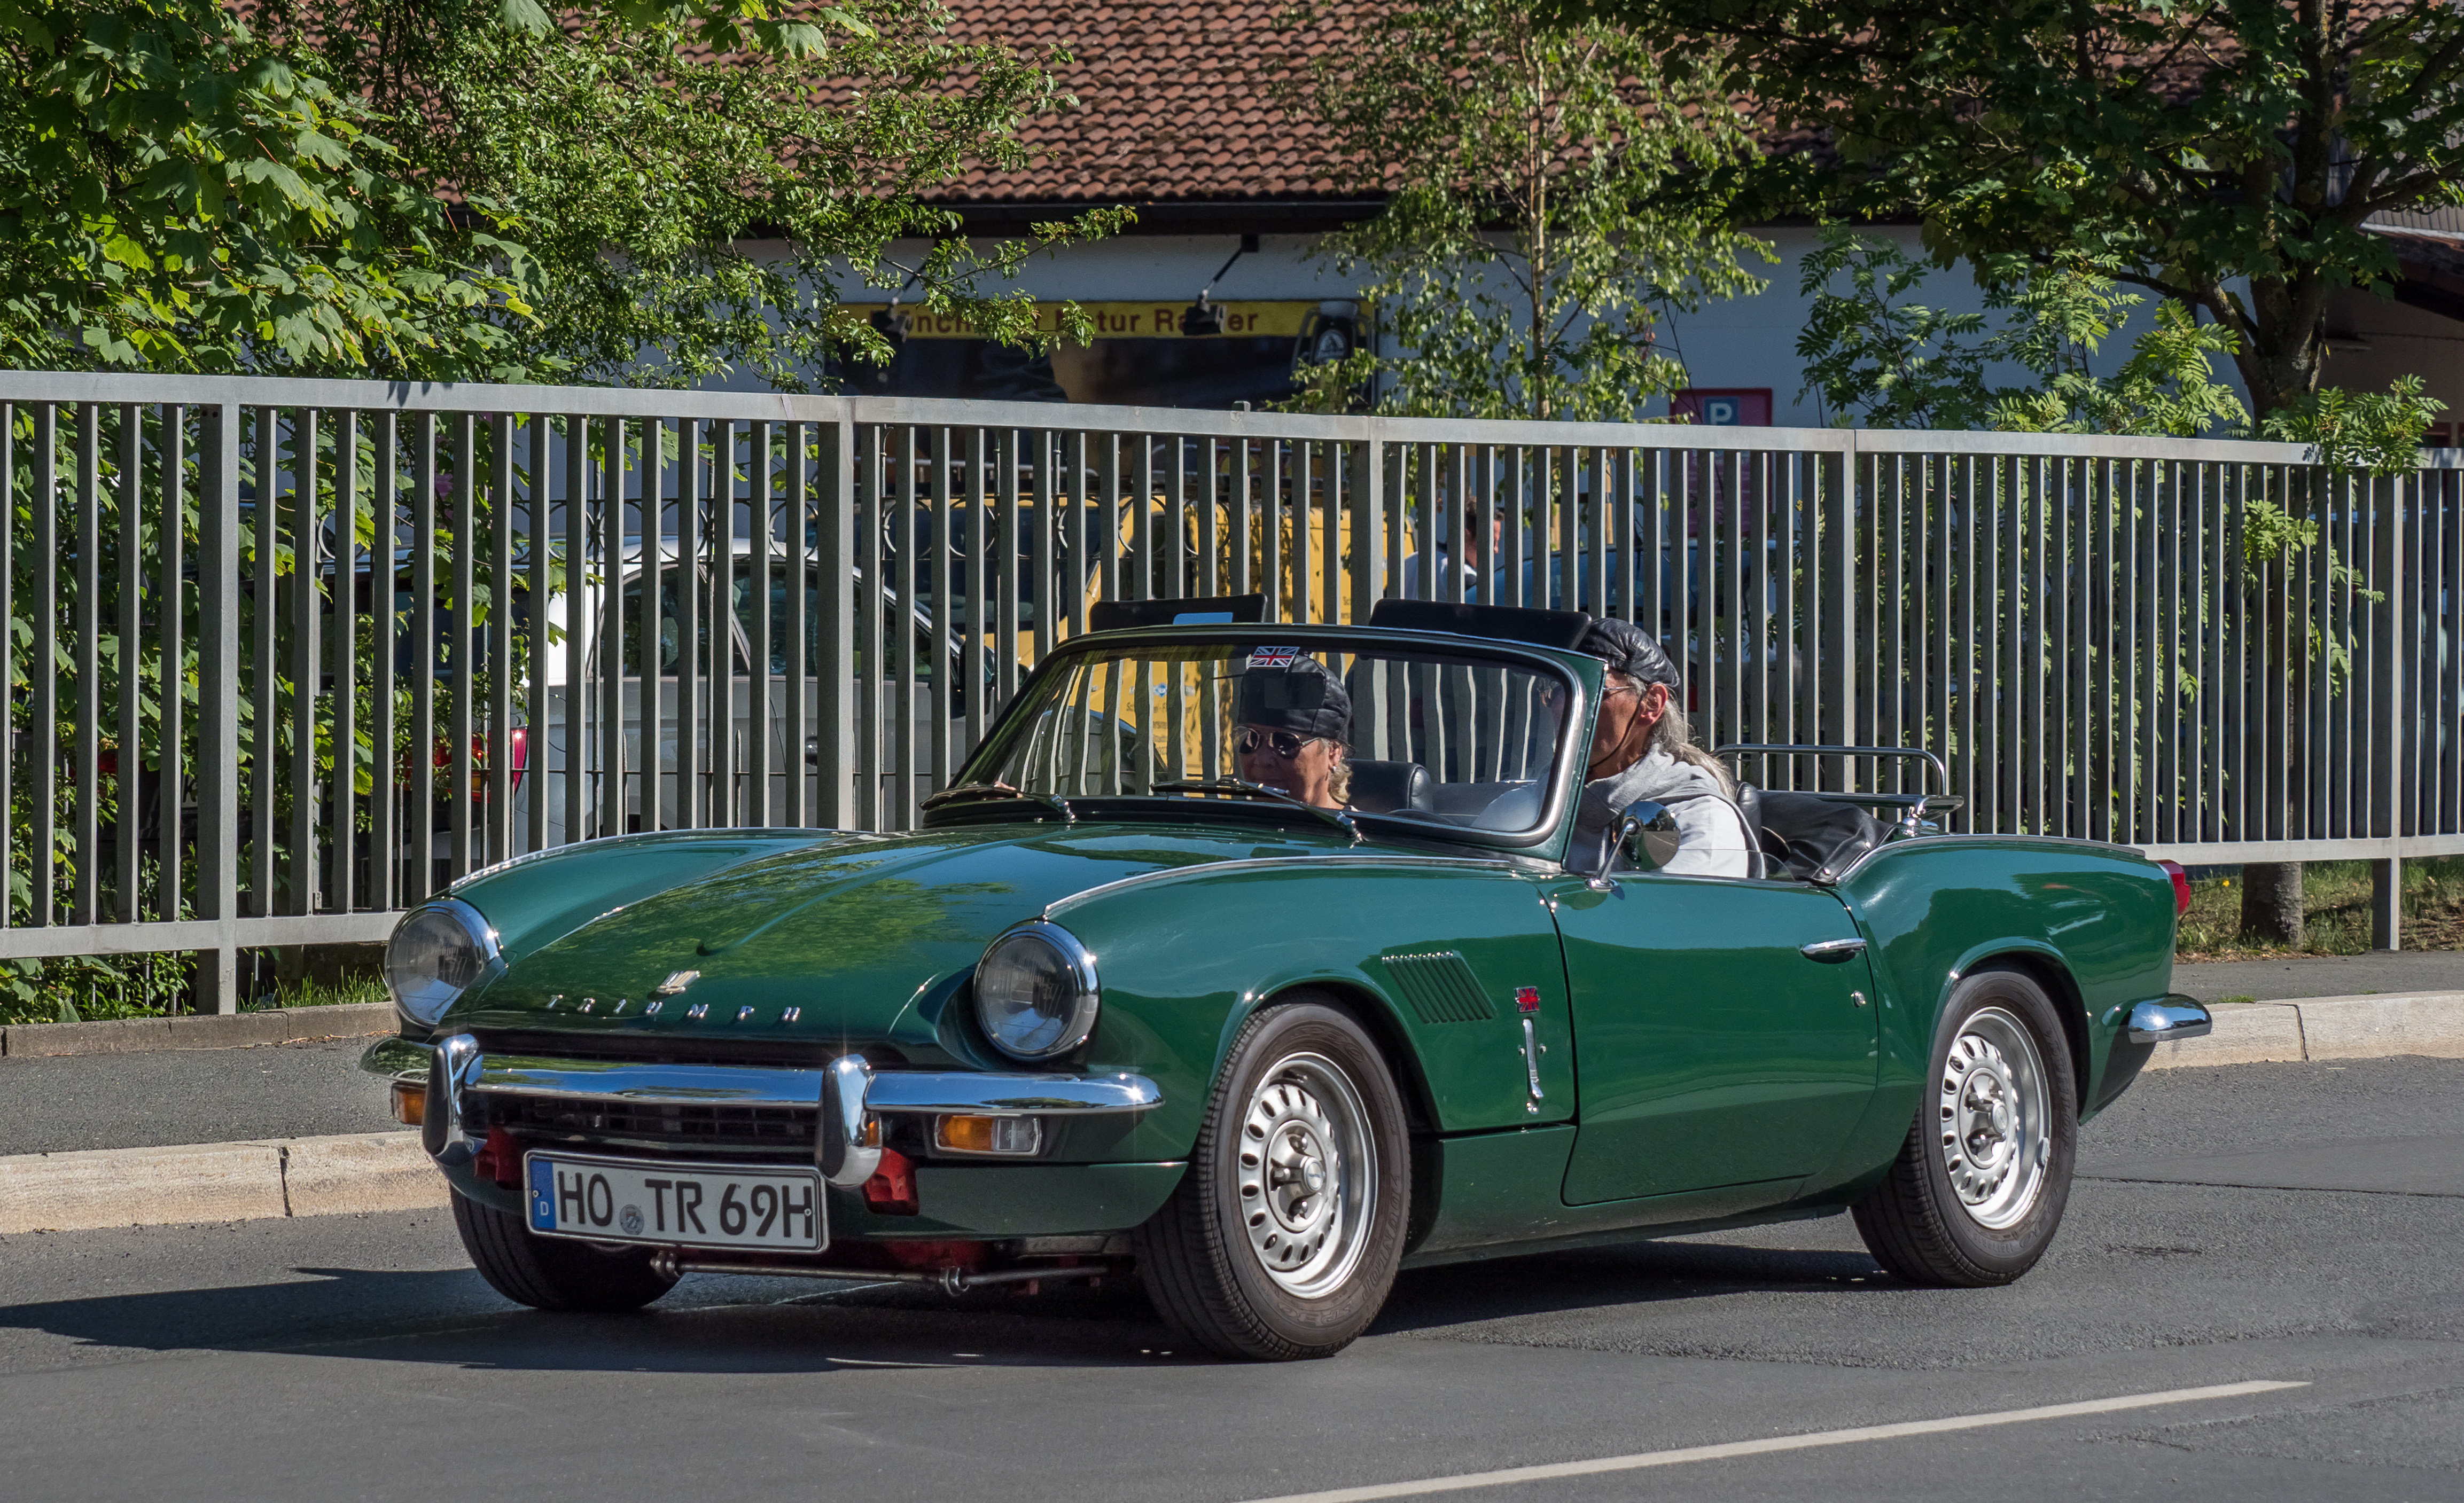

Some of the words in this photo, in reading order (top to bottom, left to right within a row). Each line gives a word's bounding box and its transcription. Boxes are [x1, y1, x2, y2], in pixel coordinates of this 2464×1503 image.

[1055, 309, 1141, 332] tur
[1155, 309, 1258, 332] Rer
[1710, 402, 1732, 426] P
[546, 994, 800, 1022] TRIUMPH
[540, 1201, 549, 1216] D
[558, 1170, 613, 1227] HO
[644, 1178, 707, 1234] TR
[720, 1183, 813, 1239] 69H
